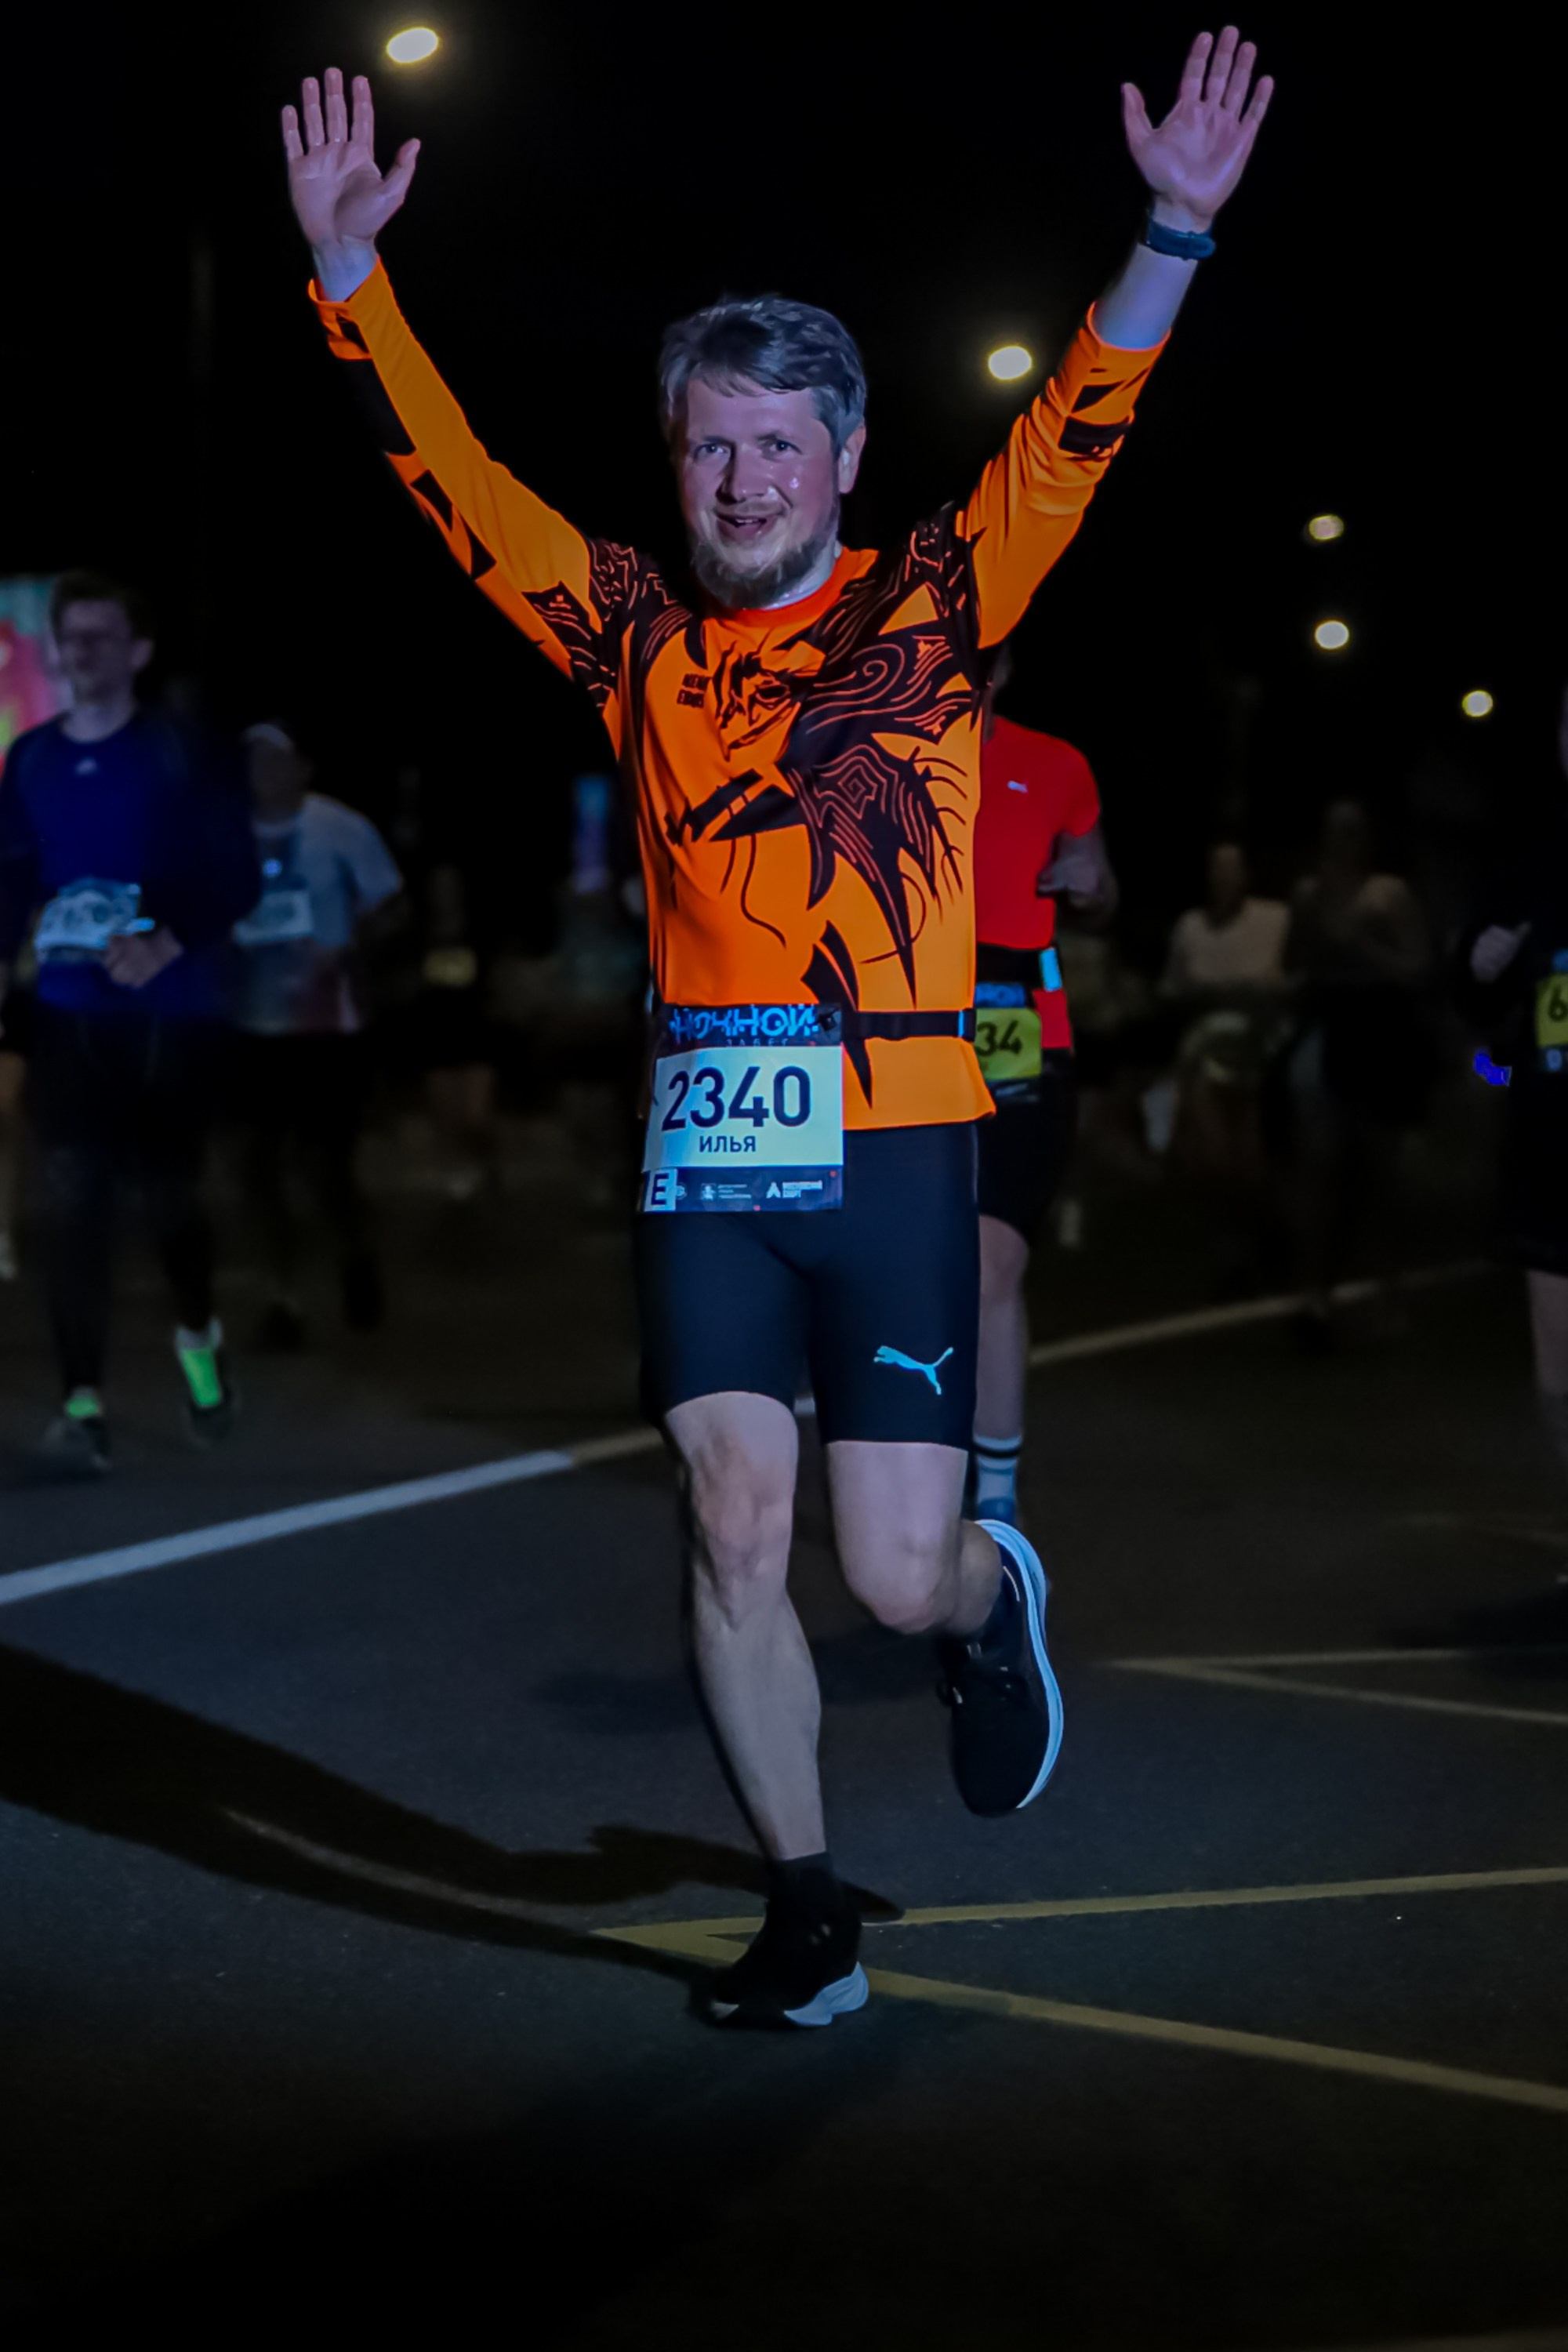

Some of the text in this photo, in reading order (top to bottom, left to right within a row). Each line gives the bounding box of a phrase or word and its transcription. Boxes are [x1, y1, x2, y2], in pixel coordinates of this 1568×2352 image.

[670, 1004, 819, 1043] НОЧНОЙ
[662, 1065, 811, 1131] 2340
[699, 1135, 756, 1152] ИЛЬЯ
[652, 1173, 670, 1205] E
